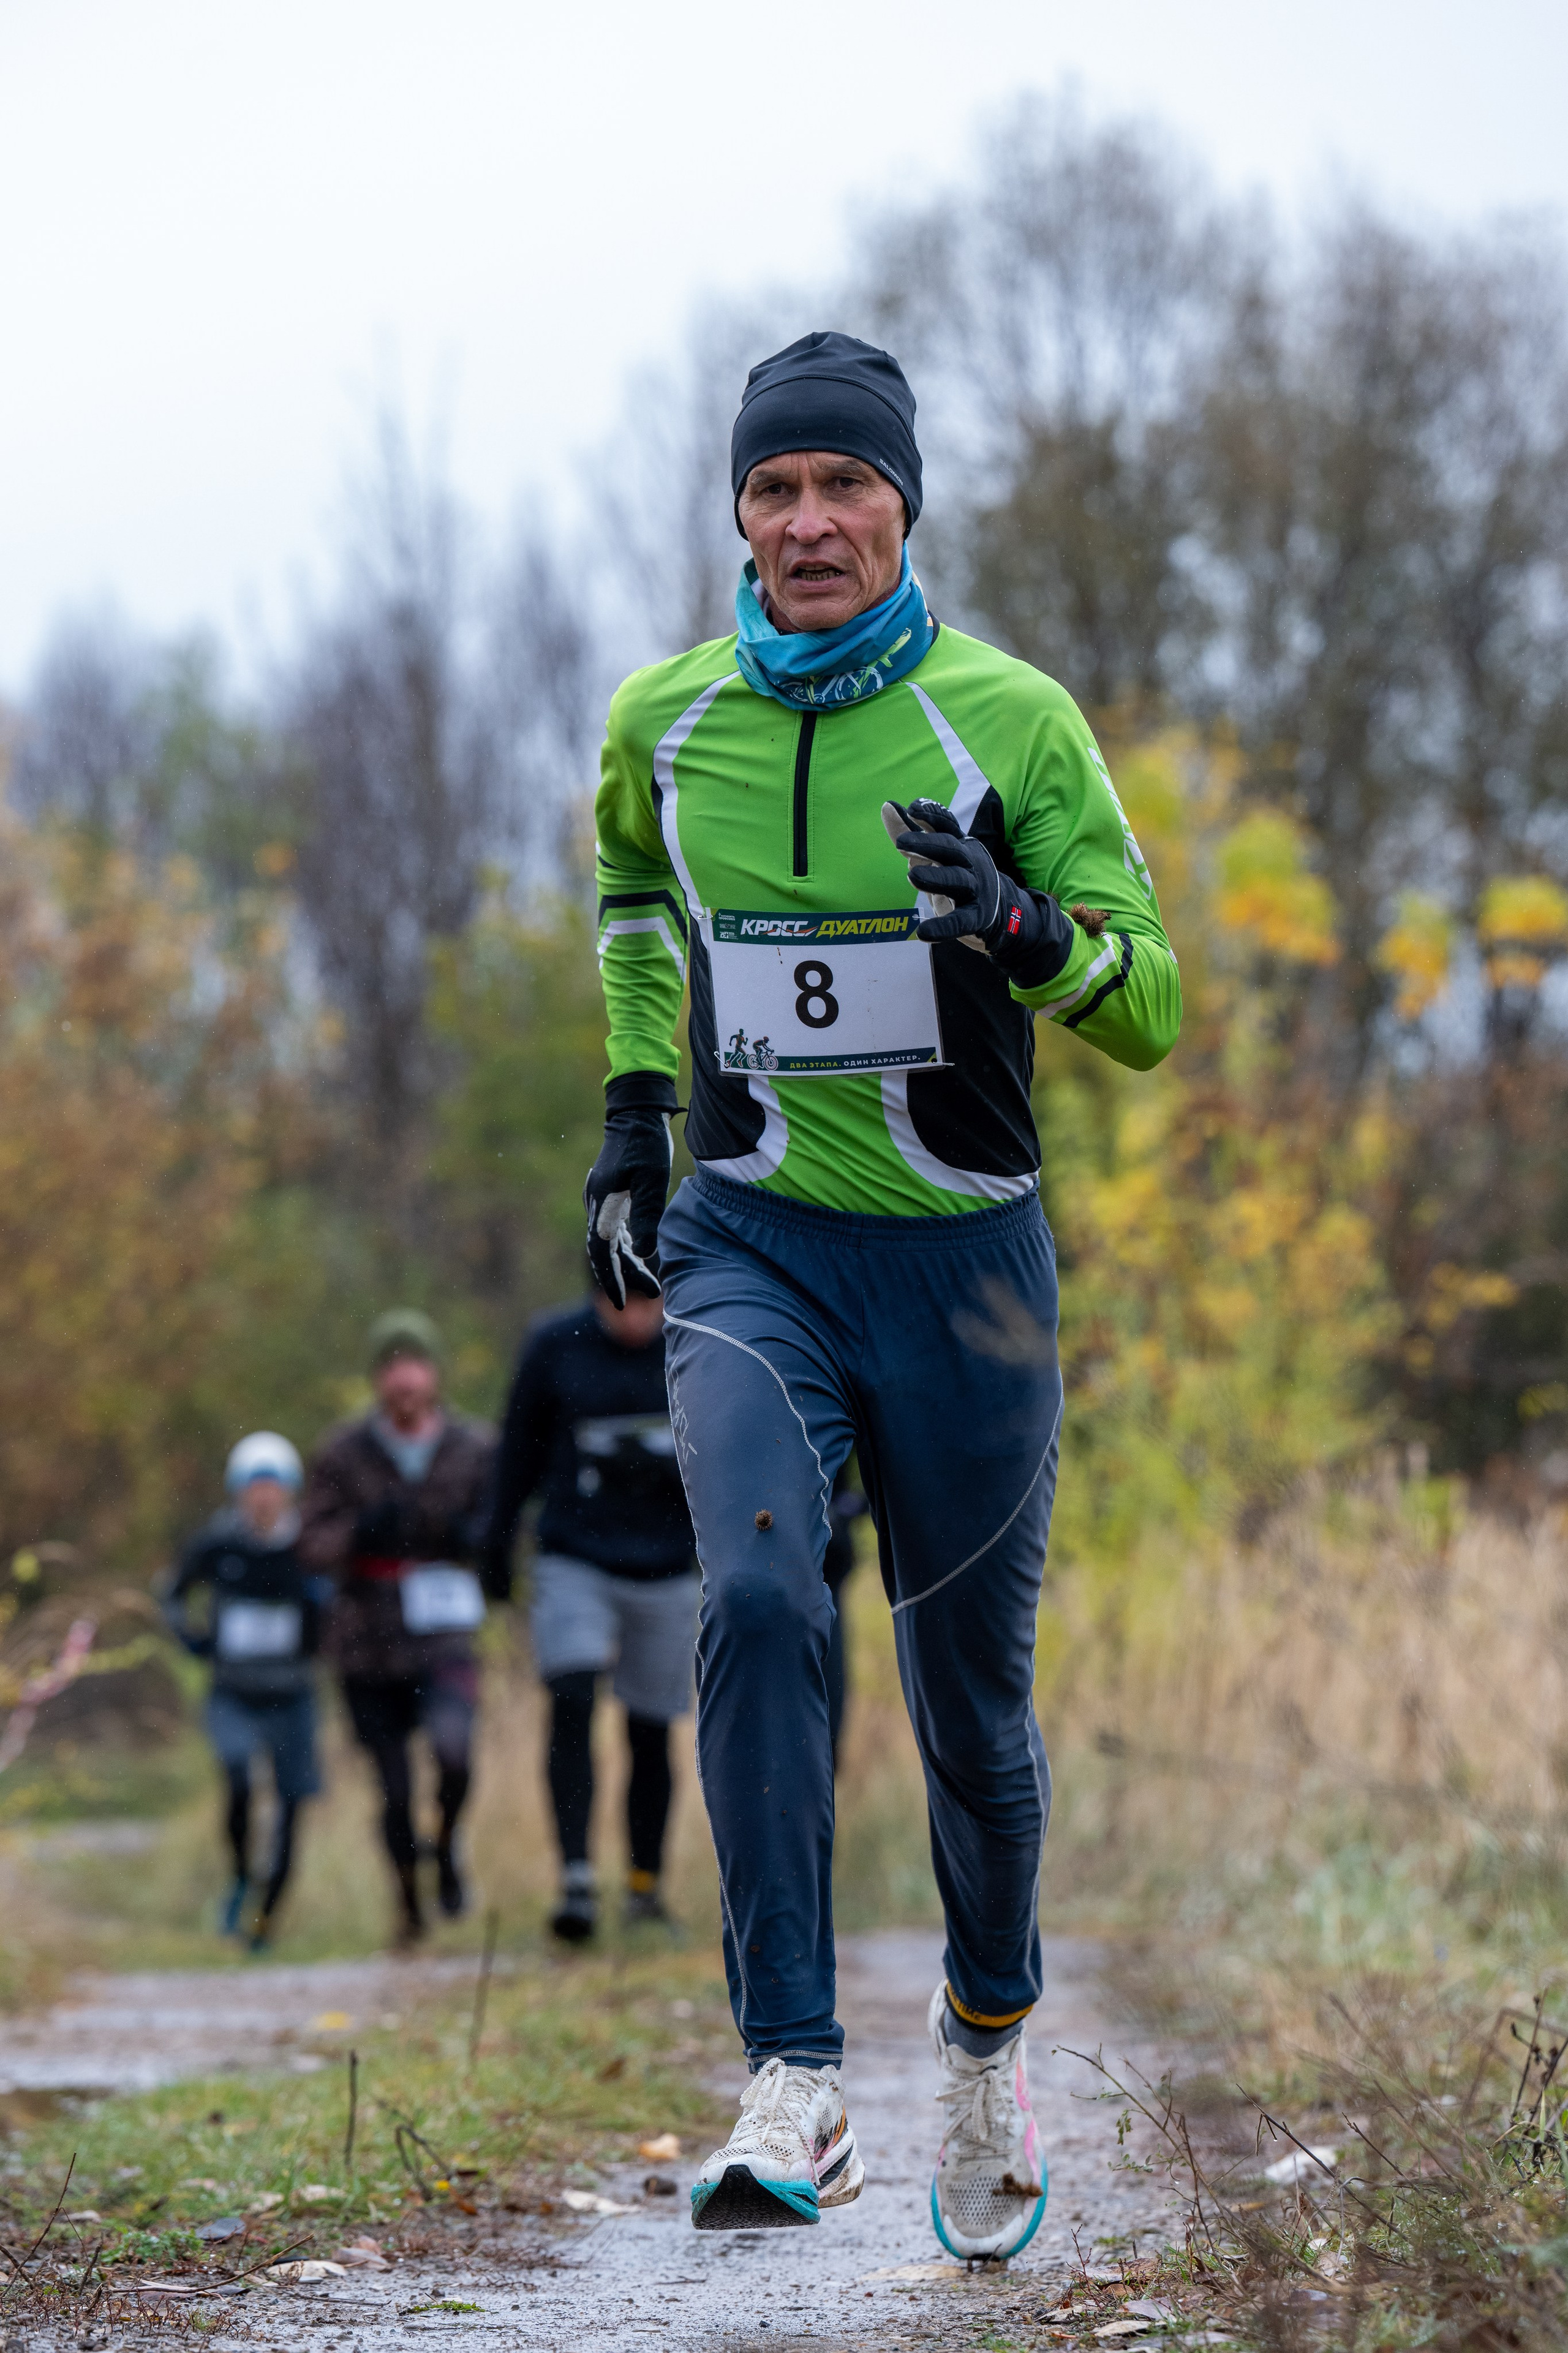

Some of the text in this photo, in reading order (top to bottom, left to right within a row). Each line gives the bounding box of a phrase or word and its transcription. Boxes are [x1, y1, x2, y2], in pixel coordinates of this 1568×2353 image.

[879, 458, 903, 486] SALOMON
[741, 918, 816, 937] КРОСС
[815, 916, 909, 938] ДУАТЛОН
[793, 960, 839, 1029] 8
[871, 1055, 921, 1064] ХАРАКТЕР.
